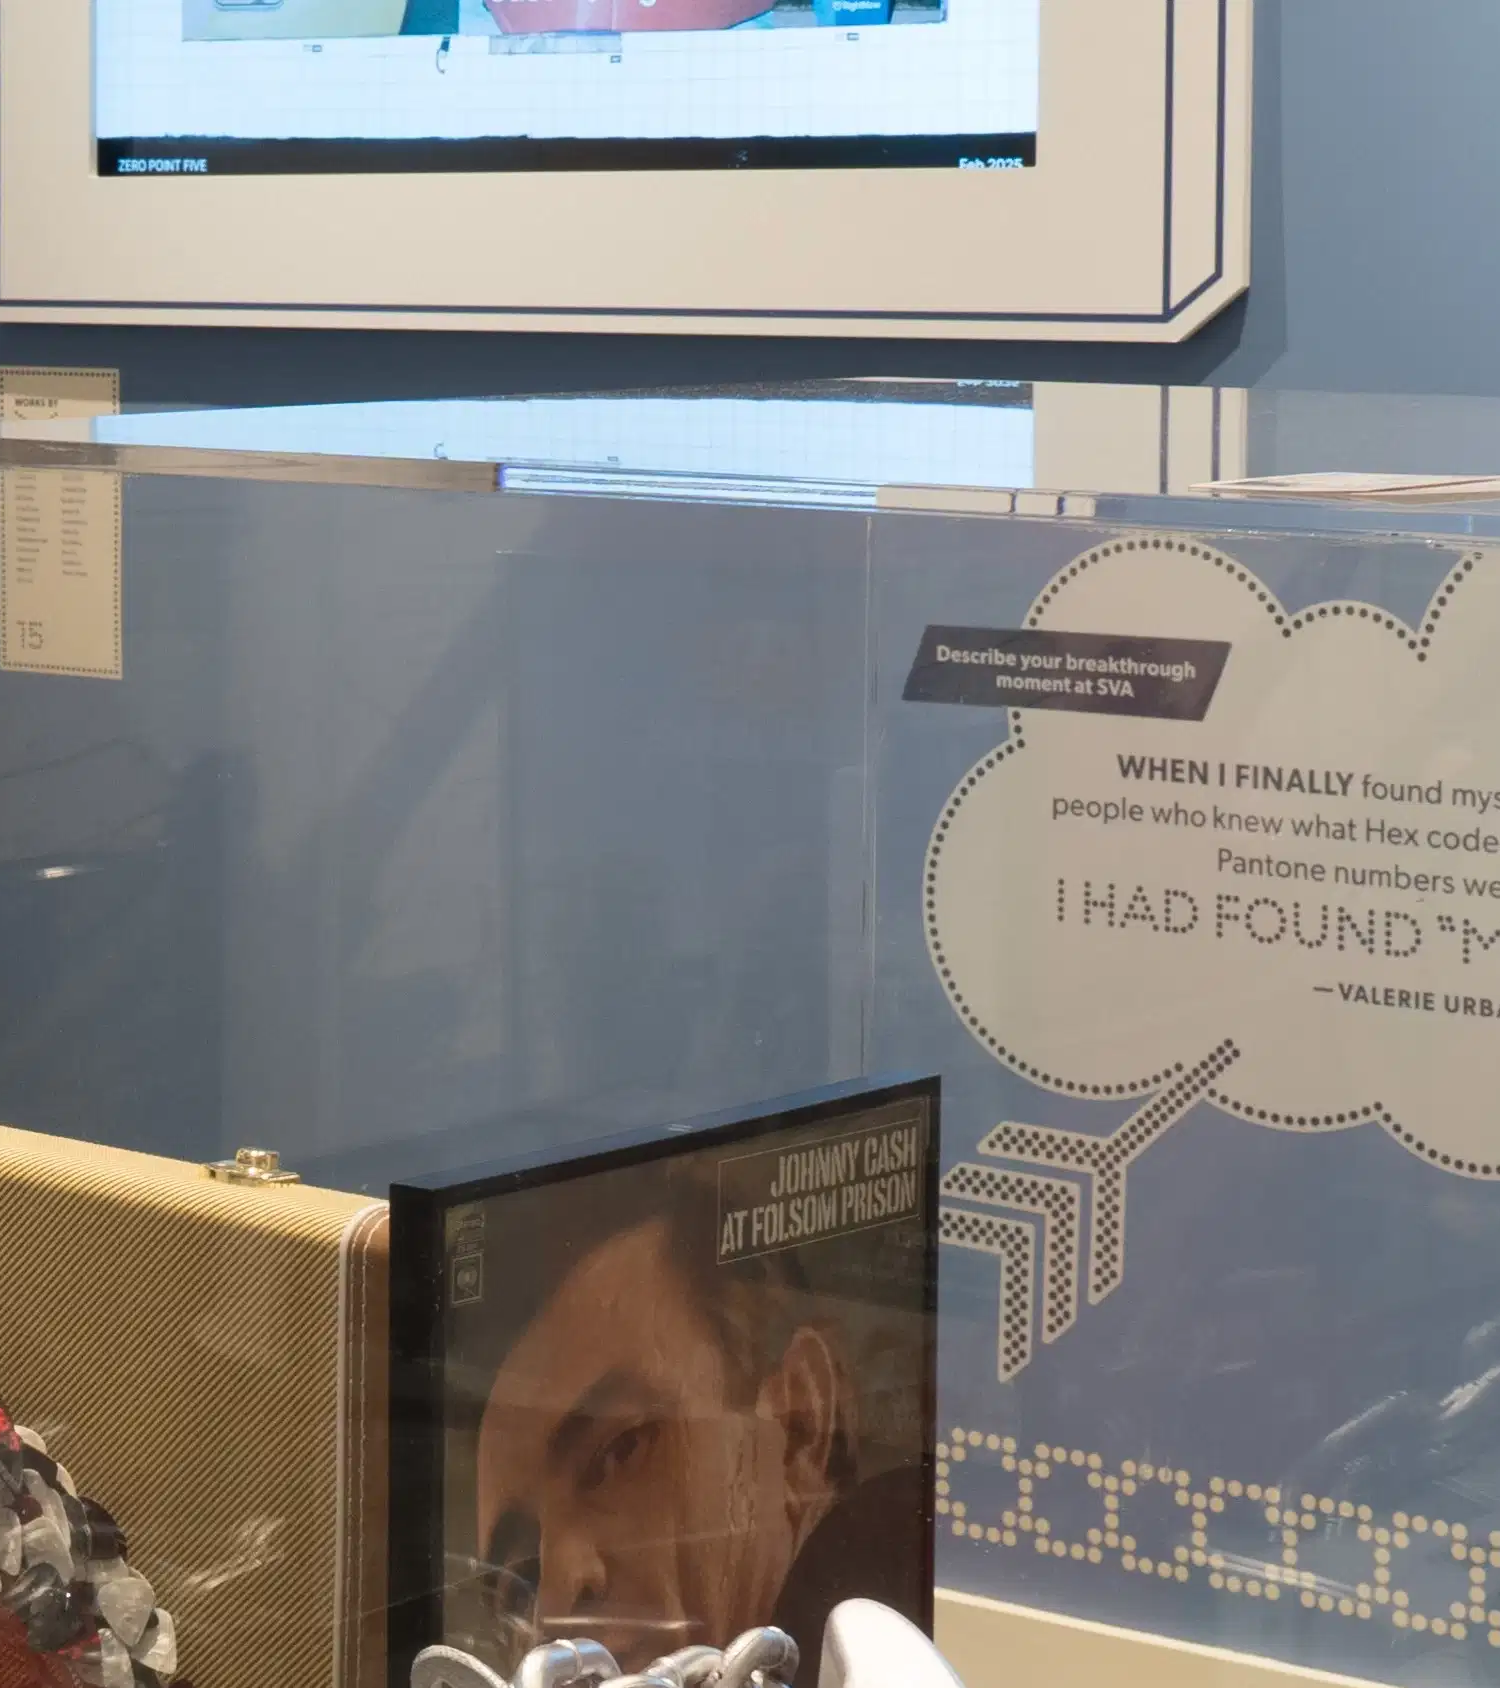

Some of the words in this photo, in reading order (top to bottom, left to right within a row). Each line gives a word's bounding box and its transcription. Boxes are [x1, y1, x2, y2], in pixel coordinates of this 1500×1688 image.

[118, 159, 146, 172] ZERO
[148, 159, 181, 172] POINT
[183, 159, 207, 172] FIVE
[959, 158, 985, 168] Feb
[987, 158, 1023, 168] 2025
[936, 645, 1016, 667] Describe
[1021, 653, 1062, 671] your
[1066, 653, 1196, 682] breakthrough
[996, 674, 1071, 694] moment
[1075, 679, 1092, 696] at
[1097, 679, 1135, 698] SVA
[1117, 753, 1209, 785] WHEN
[1219, 762, 1225, 787] I
[1235, 764, 1354, 797] FINALLY
[1362, 774, 1442, 804] found
[1052, 796, 1144, 824] people
[1151, 802, 1206, 829] who
[1213, 805, 1283, 835] knew
[1291, 814, 1357, 842] what
[1366, 818, 1419, 847] Hex
[1217, 848, 1325, 882] Pantone
[1335, 864, 1455, 895] numbers
[1058, 878, 1064, 922] I
[1083, 881, 1199, 934] HAD
[1216, 893, 1422, 958] FOUND
[771, 1141, 859, 1197] JOHNNY
[864, 1127, 916, 1176] CASH
[720, 1210, 748, 1255] AT
[753, 1191, 837, 1246] FOLSOM
[841, 1171, 915, 1224] PRISON
